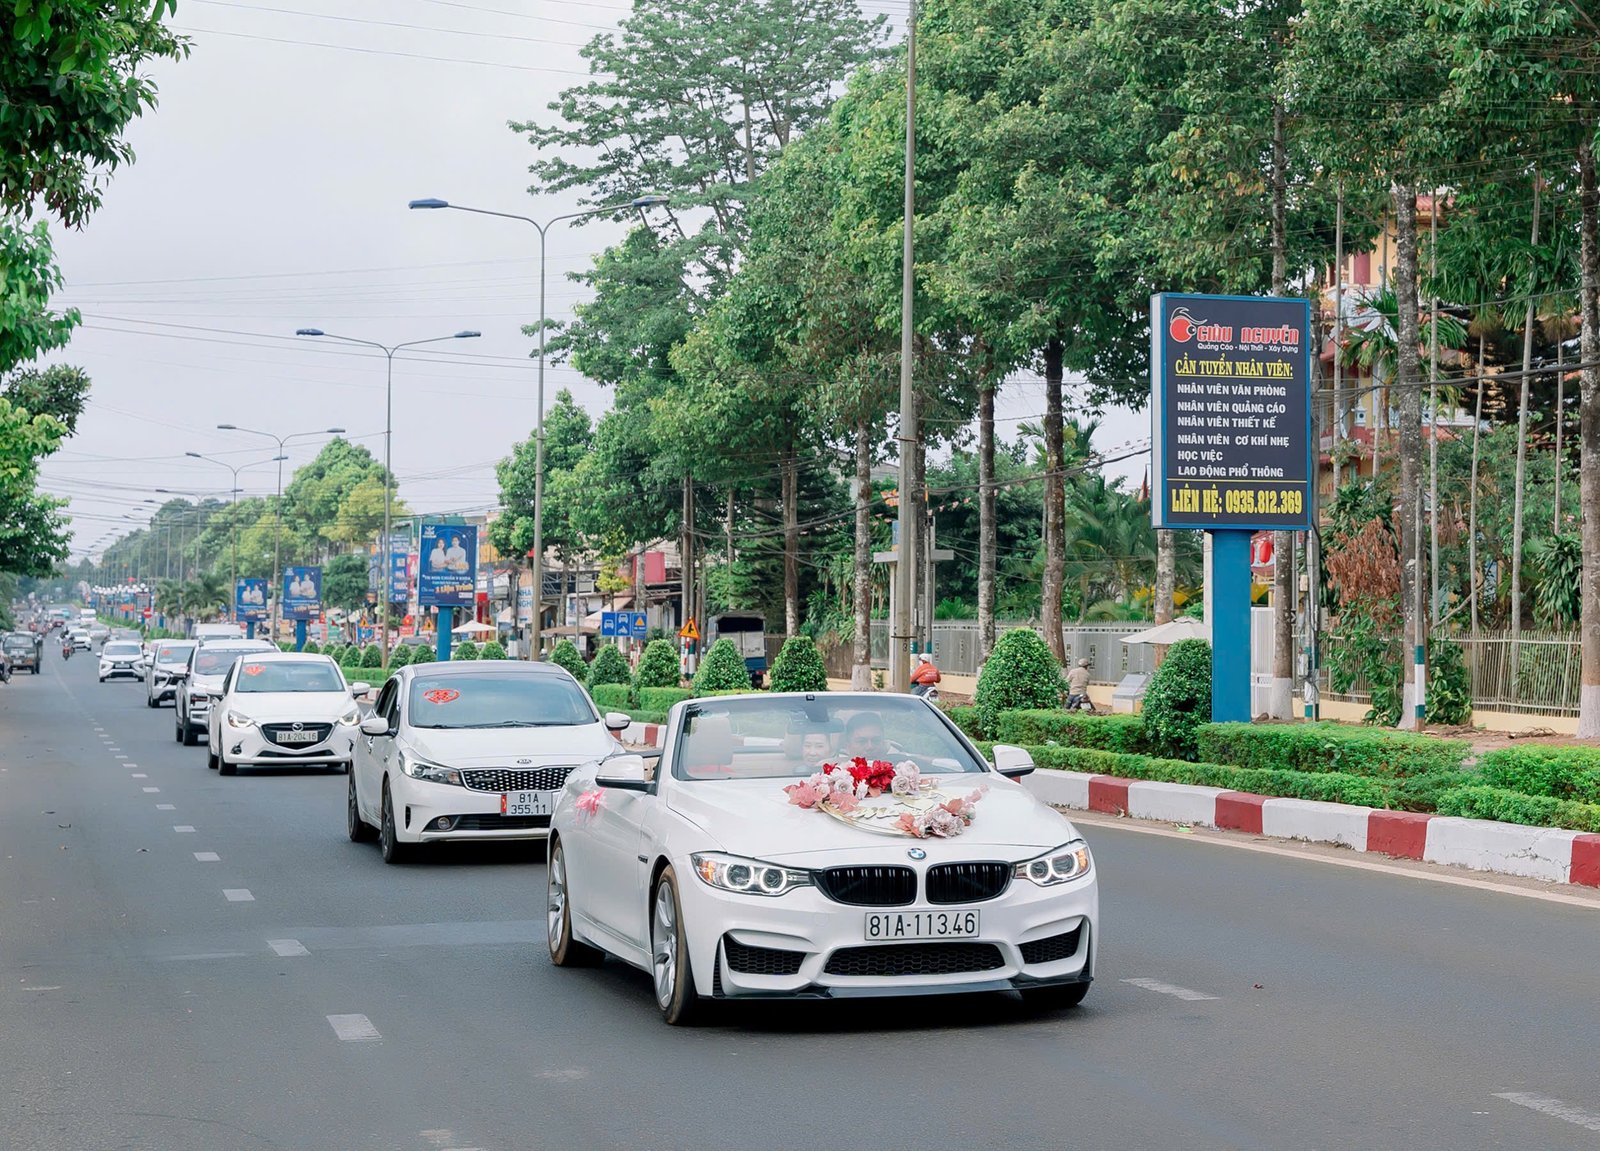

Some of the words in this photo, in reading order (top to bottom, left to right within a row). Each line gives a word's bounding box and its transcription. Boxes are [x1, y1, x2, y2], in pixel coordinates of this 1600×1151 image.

[1175, 352, 1196, 374] CẦN
[1199, 353, 1233, 375] TUYỂN
[1235, 358, 1263, 376] NHÂN
[1266, 359, 1293, 376] VIÊN:
[1177, 382, 1204, 394] NHÂN
[1206, 383, 1229, 395] VIÊN
[1231, 384, 1251, 395] VĂN
[1253, 384, 1286, 396] PHÒNG
[1177, 399, 1204, 411] NHÂN
[1206, 400, 1230, 412] VIÊN
[1231, 400, 1264, 414] QUẢNG
[1266, 402, 1286, 413] CÁO
[1177, 415, 1204, 427] NHÂN
[1207, 416, 1230, 427] VIÊN
[1232, 415, 1260, 428] THIẾT
[1262, 416, 1277, 428] KẾ
[1177, 433, 1205, 445] NHÂN
[1207, 433, 1230, 445] VIÊN
[1235, 435, 1249, 446] CƠ
[1251, 434, 1268, 446] KHÍ
[1270, 436, 1290, 448] NHẸ
[1177, 450, 1198, 462] HỌC
[1200, 449, 1224, 463] VIỆC
[1178, 466, 1197, 476] LAO
[1199, 465, 1227, 478] ĐỘNG
[1228, 463, 1249, 477] PHỔ
[1251, 466, 1284, 478] THÔNG
[1171, 483, 1200, 513] LIÊN
[1202, 483, 1223, 519] HỆ:
[1225, 489, 1302, 514] 0935.812.369
[519, 793, 539, 803] 81A
[511, 804, 547, 815] 355.11
[869, 912, 975, 937] 81A-113.46
